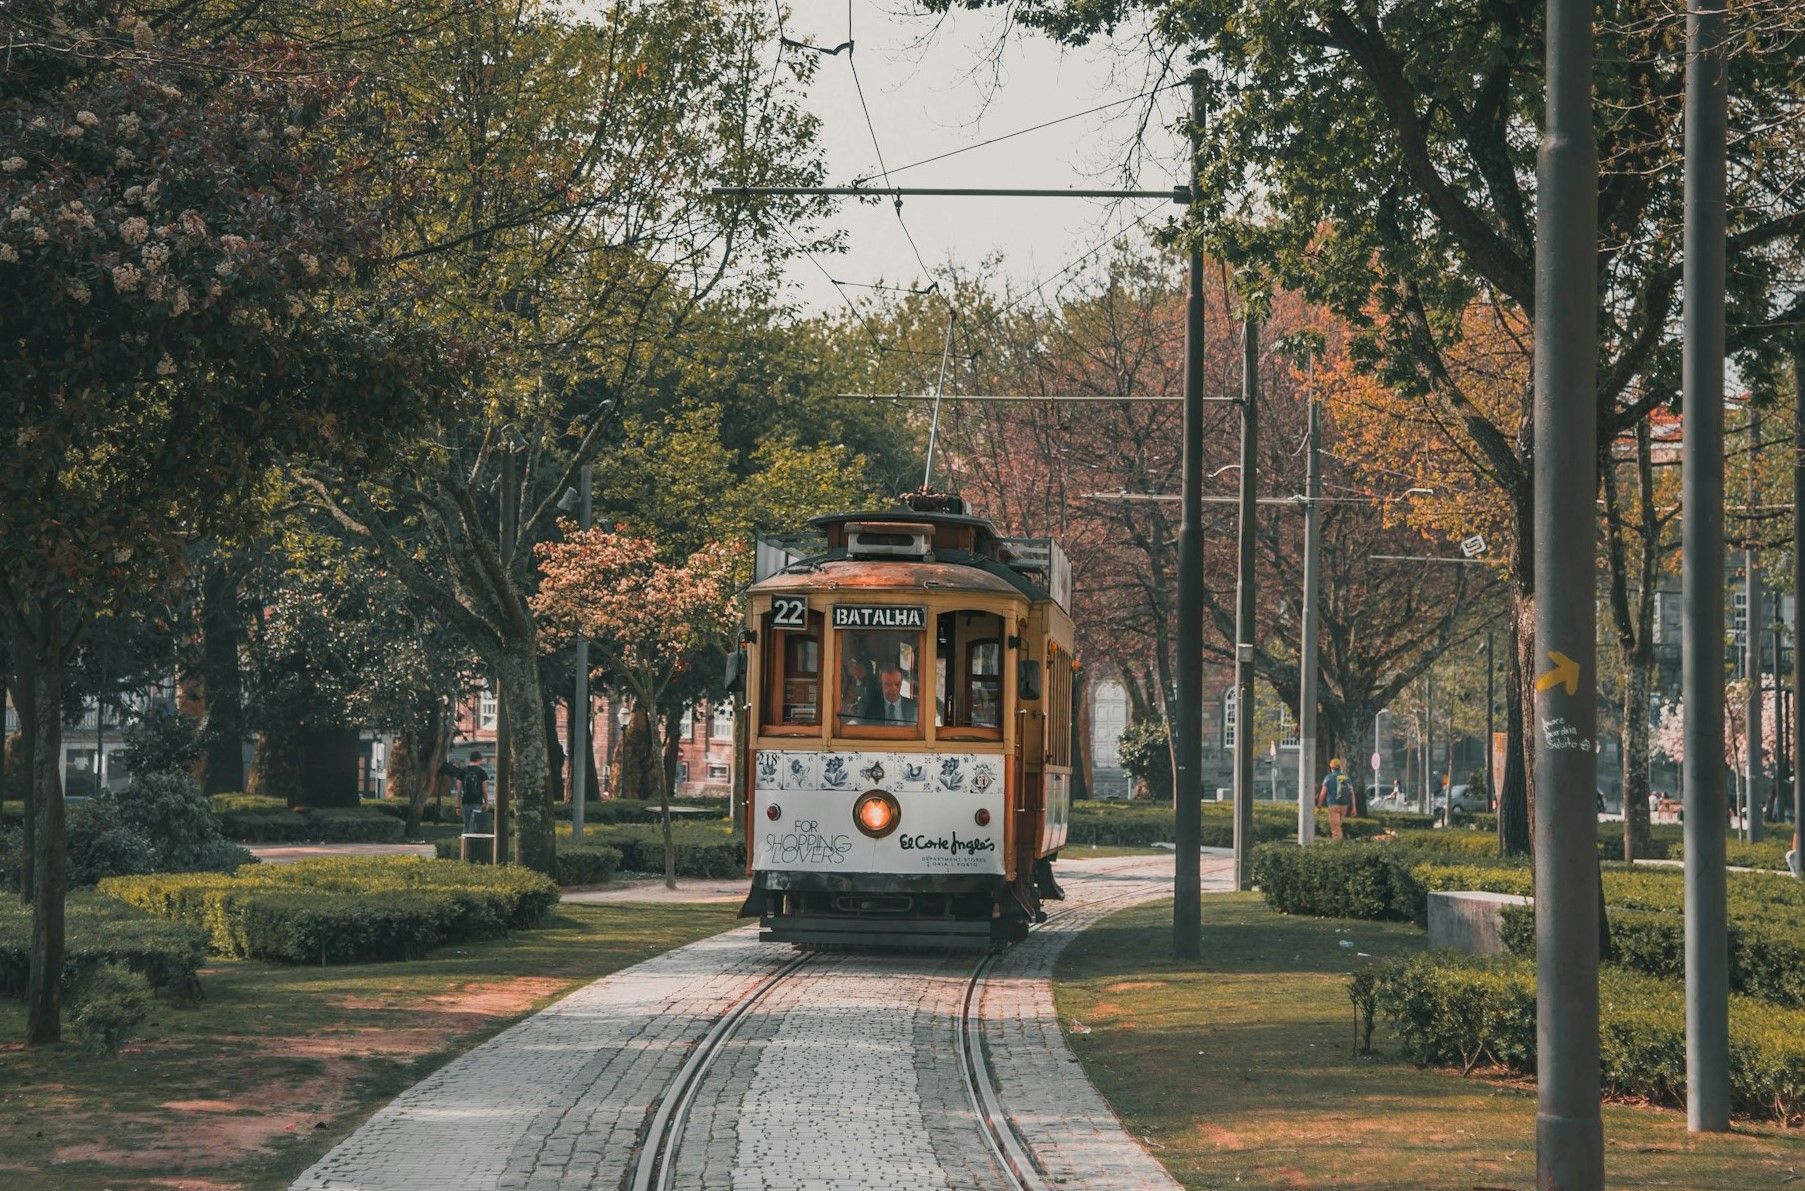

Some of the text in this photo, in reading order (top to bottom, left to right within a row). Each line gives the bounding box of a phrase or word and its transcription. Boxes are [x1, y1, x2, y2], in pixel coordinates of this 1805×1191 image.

[773, 600, 803, 624] 22
[836, 608, 921, 626] BATALHA
[757, 752, 778, 766] 218
[794, 820, 819, 833] FOR
[766, 833, 852, 852] SHOPPING
[899, 831, 995, 855] El Corte Inglés
[771, 846, 846, 864] LOVERS
